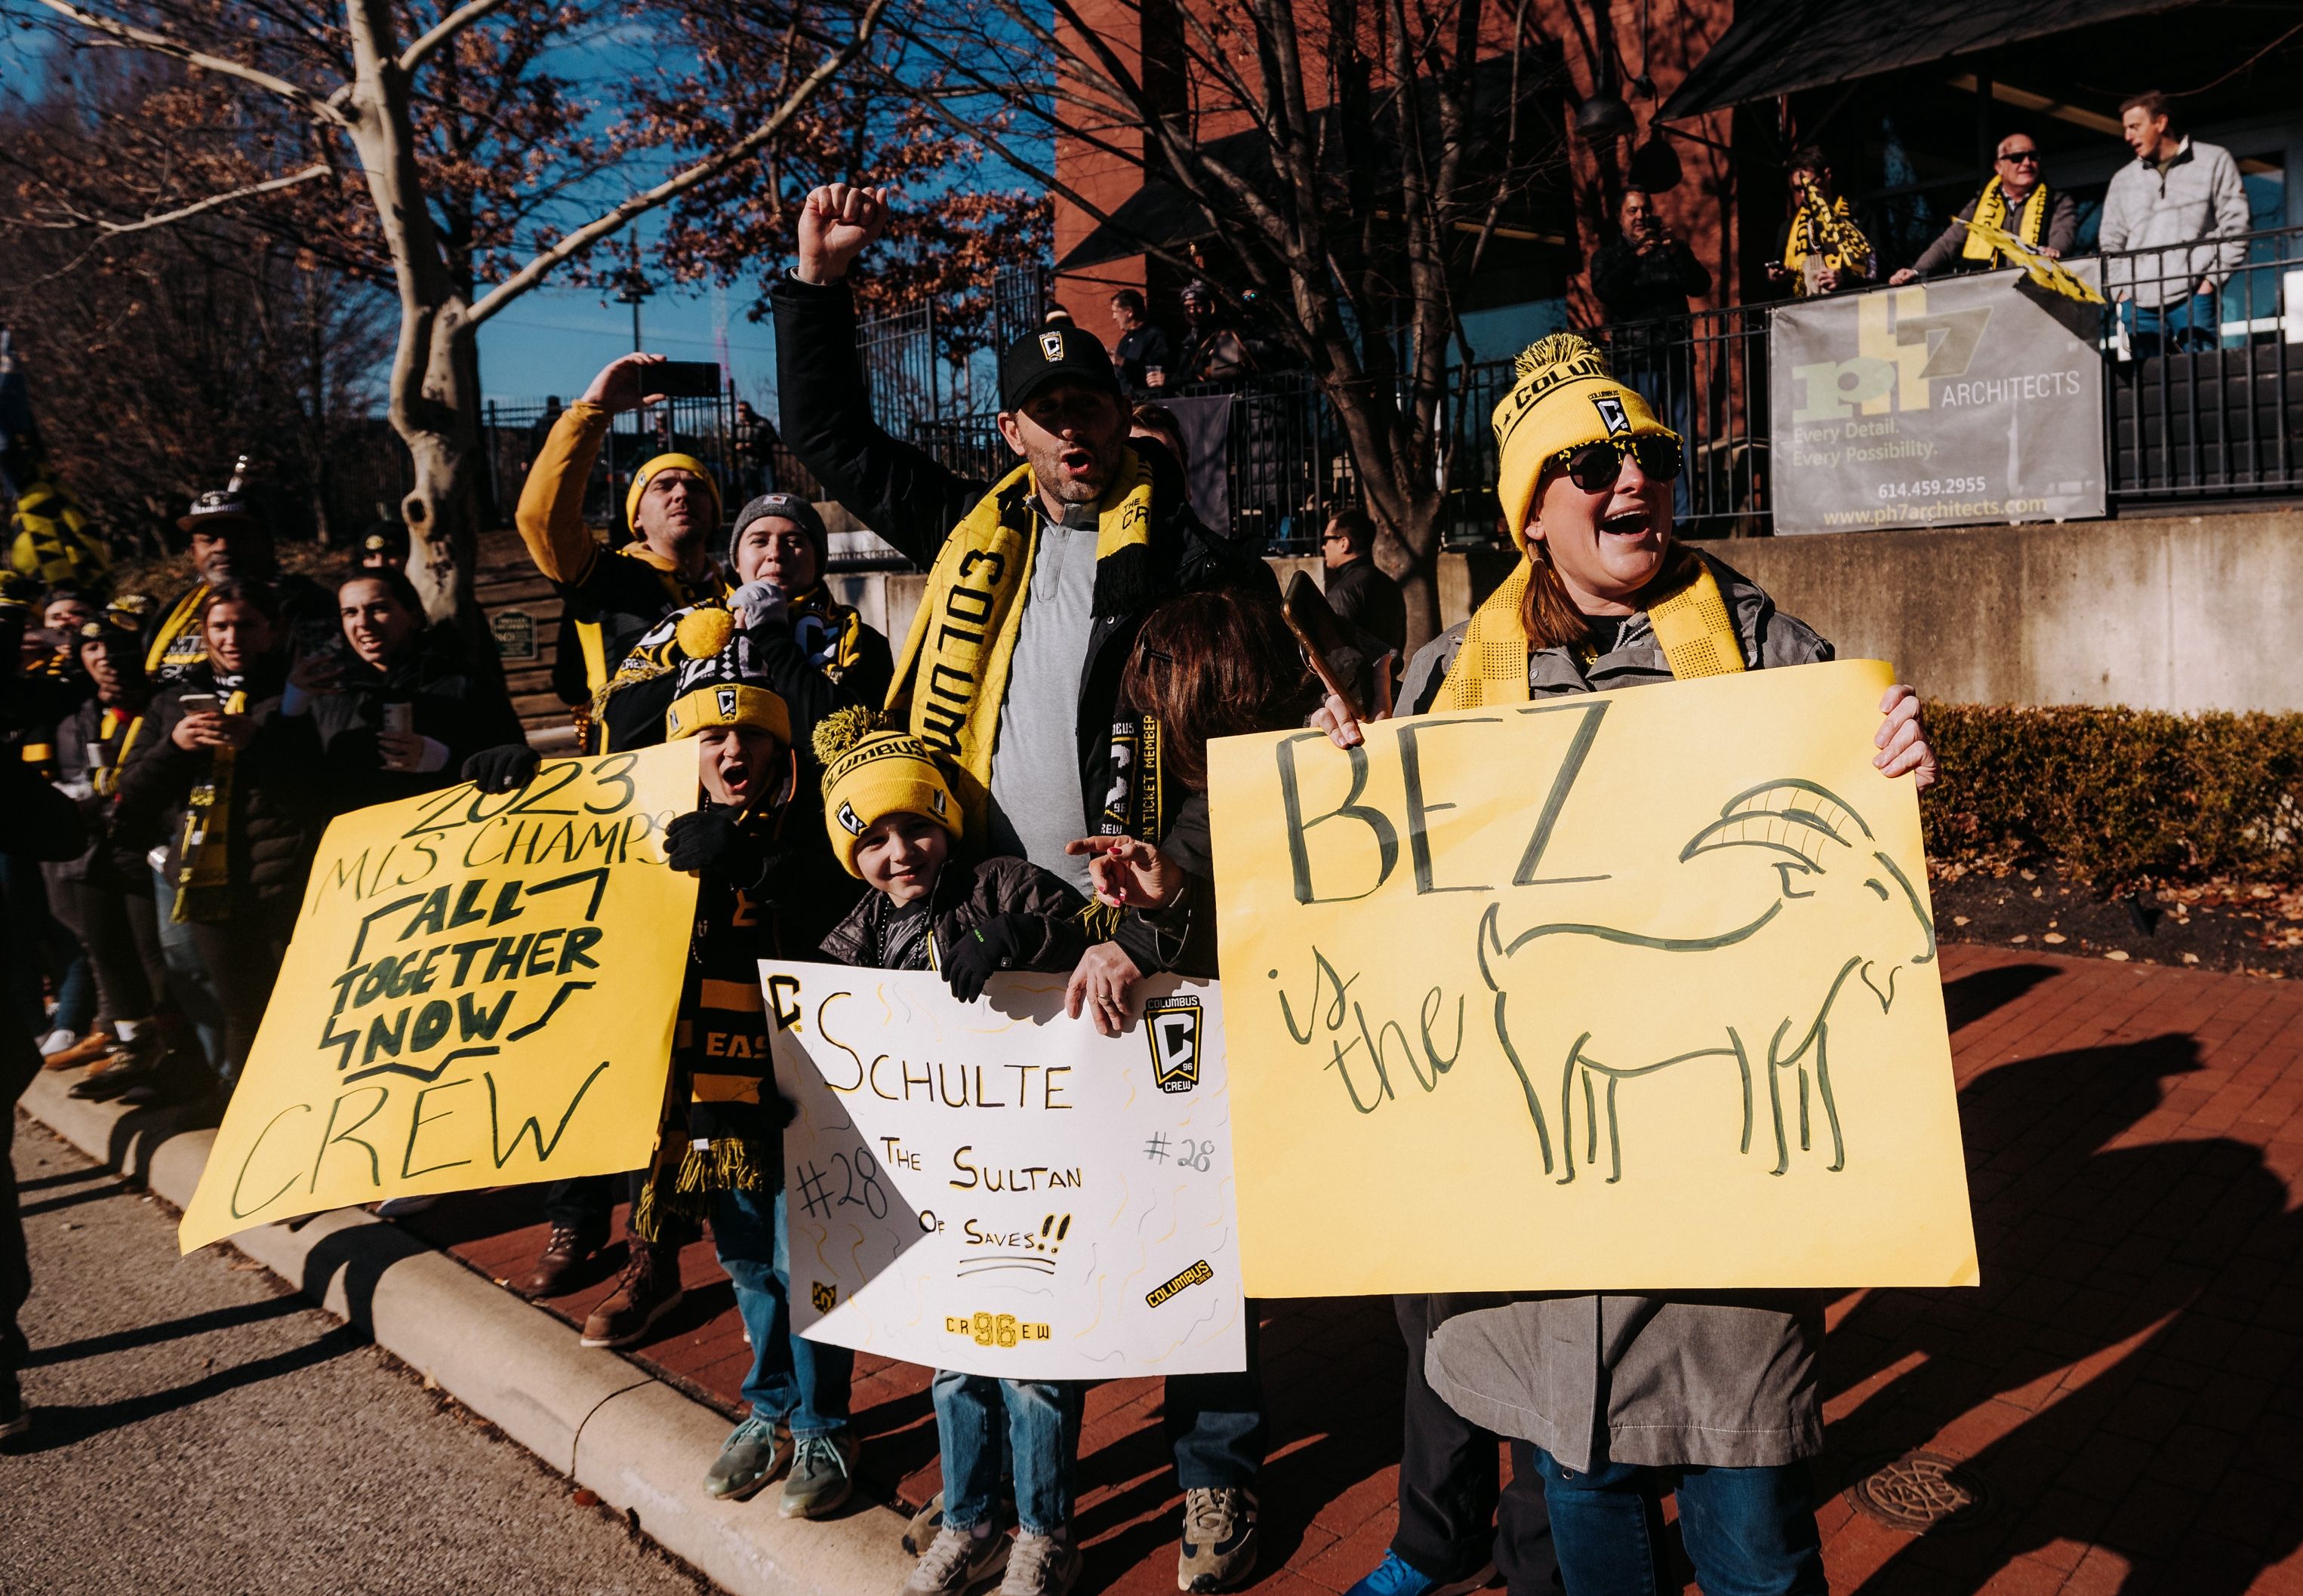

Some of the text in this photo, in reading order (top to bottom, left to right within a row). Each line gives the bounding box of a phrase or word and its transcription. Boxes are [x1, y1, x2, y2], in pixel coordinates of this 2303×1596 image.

[1941, 371, 2080, 408] ARCHITECTS
[1793, 418, 1900, 444] Every Detail.
[1793, 441, 1938, 469] Every Possibility.
[1124, 497, 1141, 512] THE
[1824, 497, 2048, 526] www.ph7architects.com
[1878, 476, 1987, 500] 614.459.2955
[1142, 715, 1156, 769] MEMBER
[401, 752, 639, 840] 2023
[1142, 774, 1156, 823] TICKET
[1276, 700, 1614, 905] BEZ
[463, 810, 677, 869] CHAMPS
[313, 832, 439, 915] MLS
[397, 878, 527, 942] ALL
[331, 927, 603, 1014] TOGETHER
[1147, 996, 1199, 1009] COLUMBUS
[1267, 946, 1360, 1045] is
[365, 989, 516, 1066] NOW
[817, 992, 1073, 1109] SCHULTE
[1323, 985, 1466, 1115] the
[1165, 1080, 1191, 1092] CREW
[1182, 1062, 1193, 1071] 96
[231, 1061, 610, 1219] CREW
[949, 1145, 1082, 1192] SULTAN
[1147, 1261, 1209, 1307] COLUMBUS
[1196, 1271, 1212, 1284] CREW
